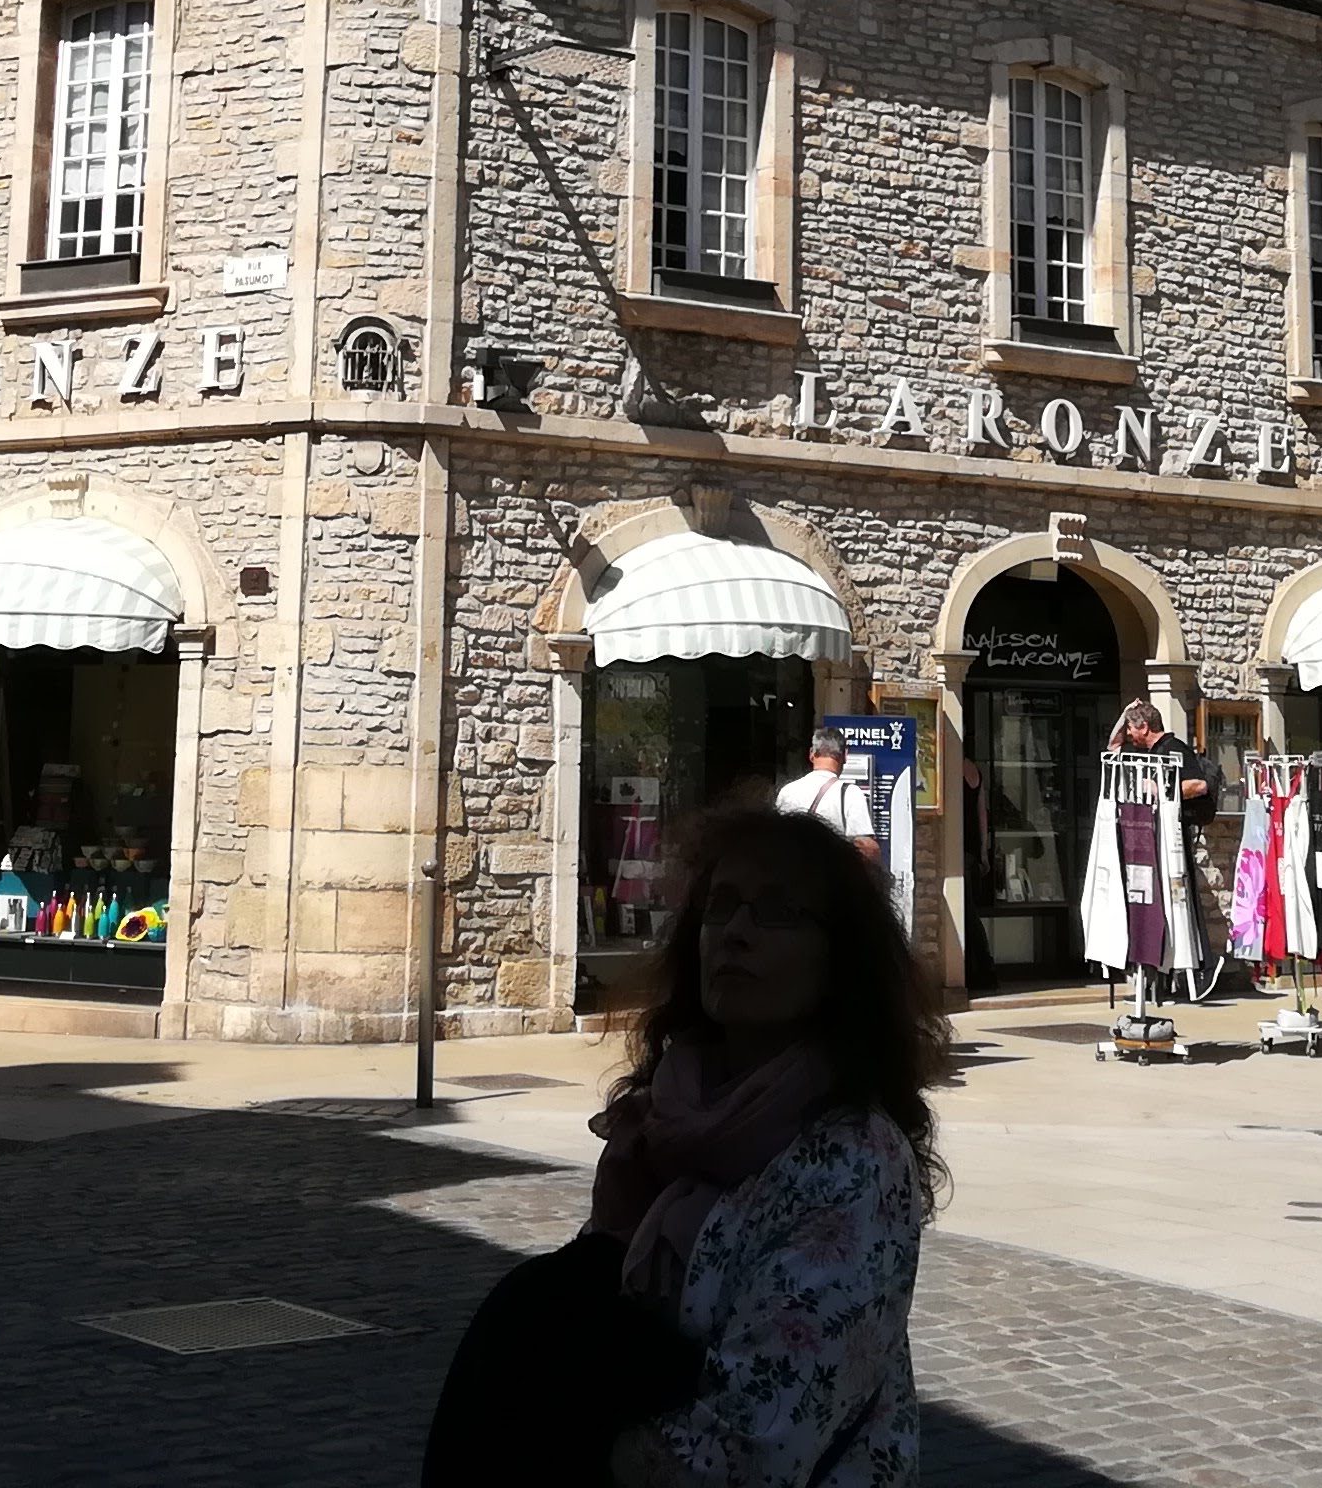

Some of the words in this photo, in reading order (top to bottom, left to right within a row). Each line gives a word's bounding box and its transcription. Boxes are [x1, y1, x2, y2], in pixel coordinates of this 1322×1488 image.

[792, 370, 1293, 474] LARONZE
[963, 632, 1058, 649] MAISON
[987, 626, 1102, 679] LARONZE
[839, 727, 890, 739] PINEL
